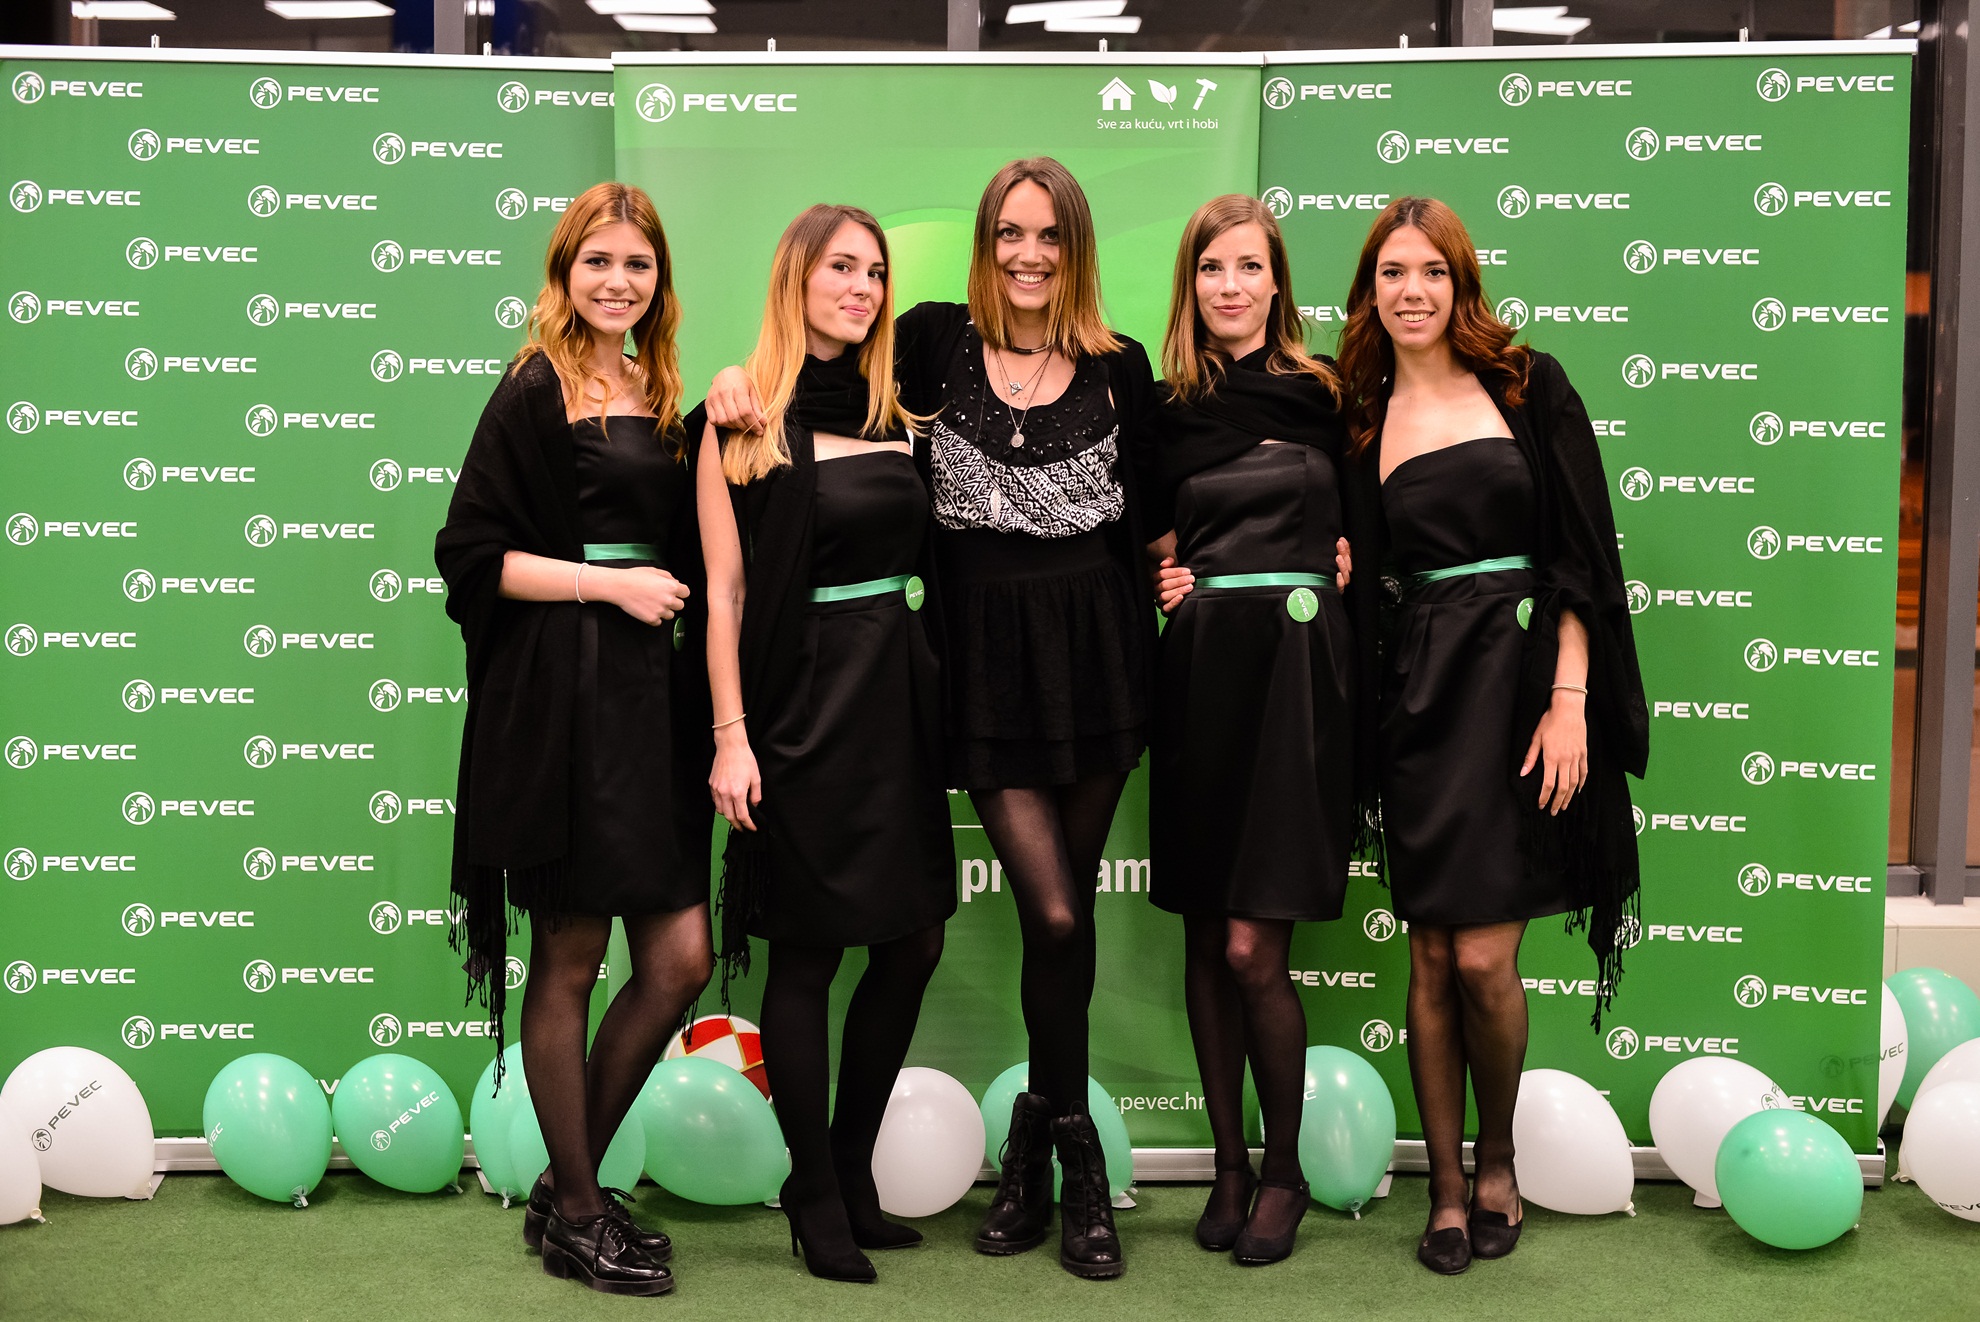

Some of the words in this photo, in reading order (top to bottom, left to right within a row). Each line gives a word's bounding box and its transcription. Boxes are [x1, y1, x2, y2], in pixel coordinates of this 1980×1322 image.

[50, 80, 144, 98] PEVEC
[1300, 83, 1392, 101] PEVEC
[1537, 79, 1633, 98] PEVEC
[1796, 75, 1895, 93] PEVEC
[287, 85, 380, 103] PEVEC
[682, 92, 798, 112] PEVEC
[1097, 118, 1117, 129] Sve
[1119, 120, 1132, 129] za
[1135, 118, 1165, 131] kuću,
[1167, 119, 1184, 129] vrt
[1186, 118, 1190, 129] i
[1192, 118, 1219, 129] hobi
[166, 137, 260, 155] PEVEC
[410, 141, 504, 159] PEVEC
[1414, 137, 1510, 155] PEVEC
[1665, 134, 1763, 152] PEVEC
[47, 189, 141, 207] PEVEC
[285, 193, 378, 211] PEVEC
[1298, 193, 1391, 211] PEVEC
[1535, 192, 1631, 210] PEVEC
[1793, 190, 1892, 208] PEVEC
[164, 245, 258, 263] PEVEC
[409, 248, 502, 266] PEVEC
[1662, 248, 1760, 266] PEVEC
[46, 299, 140, 317] PEVEC
[284, 302, 377, 319] PEVEC
[1534, 305, 1629, 323] PEVEC
[1791, 306, 1890, 323] PEVEC
[163, 356, 257, 374] PEVEC
[408, 357, 502, 375] PEVEC
[1661, 363, 1758, 381] PEVEC
[44, 409, 139, 427] PEVEC
[283, 412, 376, 429] PEVEC
[1789, 420, 1886, 438] PEVEC
[161, 466, 256, 483] PEVEC
[407, 466, 463, 484] PEV
[1658, 475, 1755, 494] PEVEC
[44, 521, 138, 538] PEVEC
[282, 522, 375, 539] PEVEC
[1786, 535, 1883, 554] PEVEC
[161, 577, 256, 594] PEVEC
[1656, 589, 1753, 608] PEVEC
[43, 631, 137, 648] PEVEC
[281, 632, 375, 649] PEVEC
[1783, 647, 1880, 667] PEVEC
[160, 687, 255, 704] PEVEC
[407, 687, 468, 704] PEV
[1653, 701, 1750, 720] PEVEC
[43, 744, 137, 761] PEVEC
[282, 743, 375, 760] PEVEC
[1780, 761, 1876, 781] PEVEC
[160, 799, 255, 817] PEVEC
[1651, 813, 1747, 833] PEVEC
[42, 855, 136, 872] PEVEC
[281, 855, 374, 872] PEVEC
[1776, 872, 1872, 893] PEVEC
[160, 910, 255, 928] PEVEC
[1648, 924, 1743, 943] PEVEC
[42, 968, 136, 985] PEVEC
[281, 967, 374, 984] PEVEC
[1772, 984, 1868, 1005] PEVEC
[160, 1023, 255, 1040] PEVEC
[1644, 1035, 1739, 1054] PEVEC
[48, 1080, 102, 1131] PEVEC
[388, 1091, 440, 1134] PEVEC
[1789, 1096, 1863, 1114] EVEC
